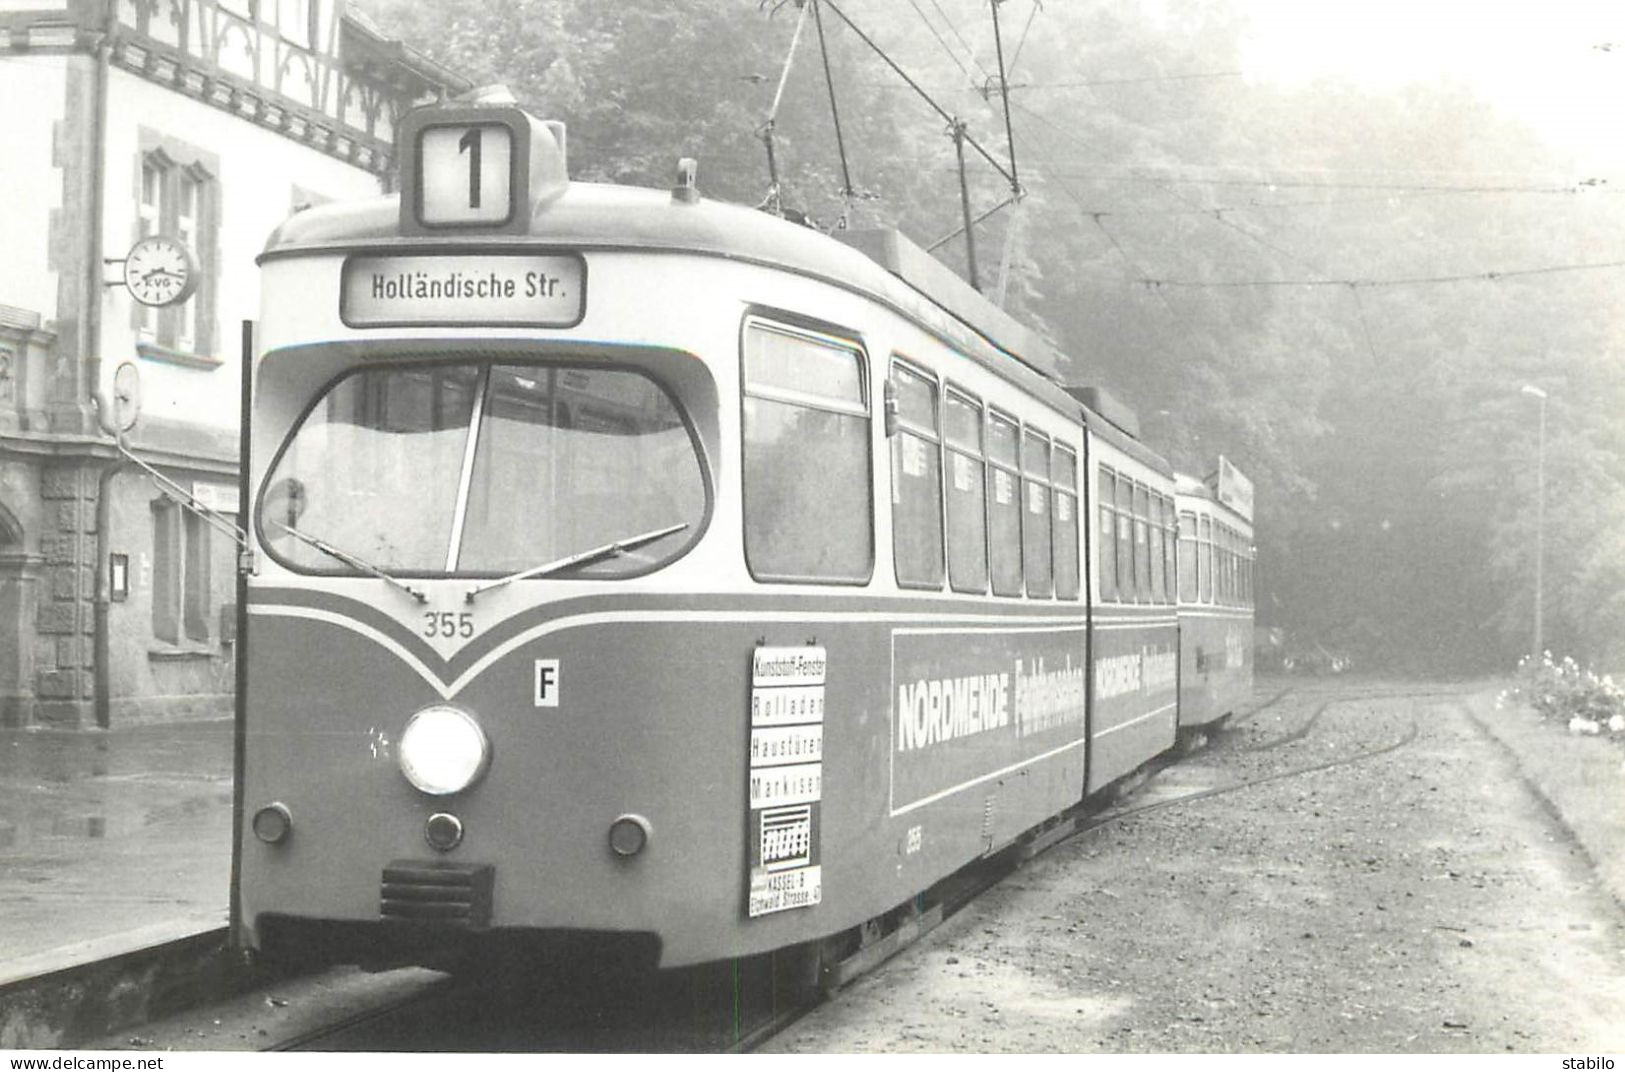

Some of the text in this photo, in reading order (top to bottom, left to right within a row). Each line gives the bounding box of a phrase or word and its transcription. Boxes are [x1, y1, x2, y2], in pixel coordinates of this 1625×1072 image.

[459, 128, 482, 209] 1
[372, 271, 567, 299] Holländische Str.
[424, 611, 474, 638] 355
[540, 667, 554, 699] F
[754, 695, 823, 717] Rolladen
[899, 672, 1009, 751] NORDMENDE
[752, 734, 822, 758] Haustüren
[752, 775, 821, 799] Markisen
